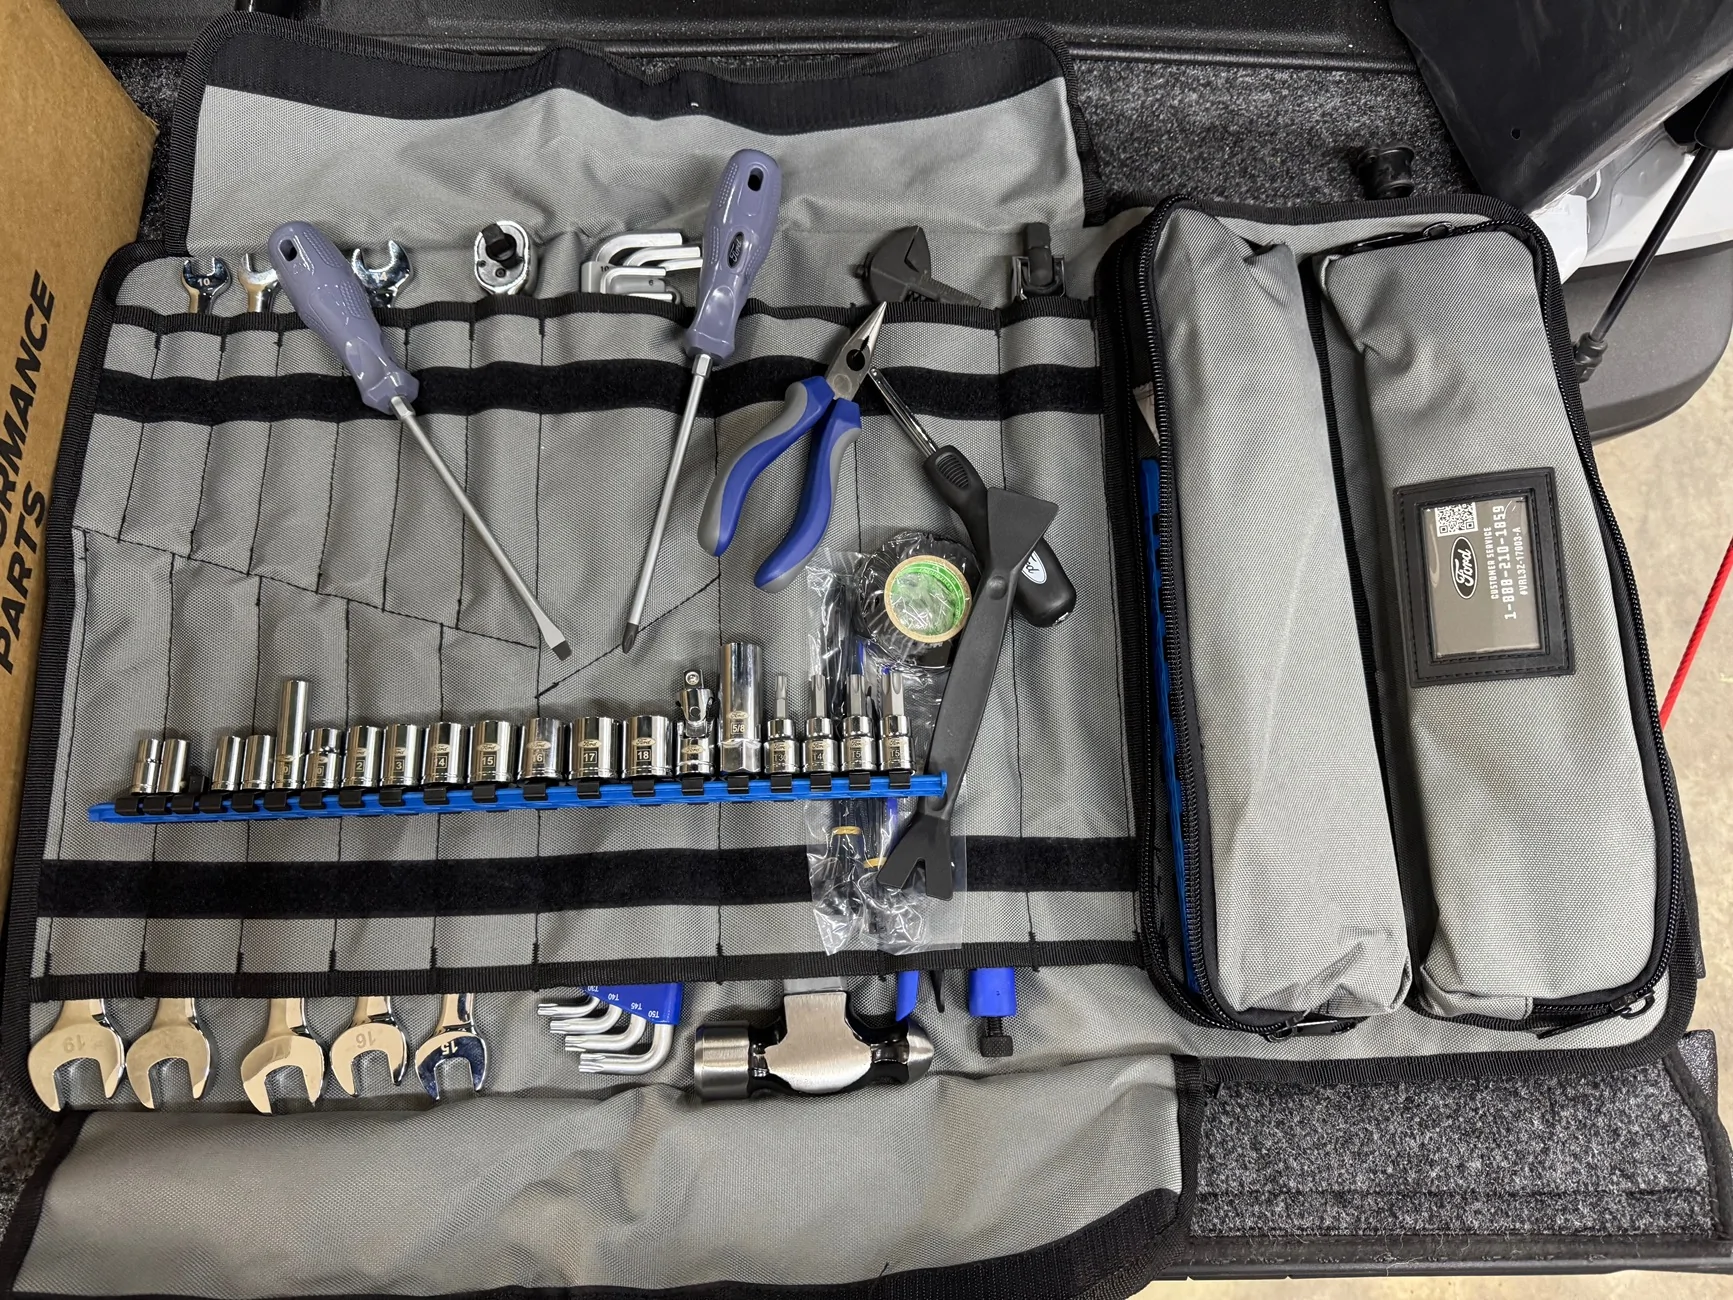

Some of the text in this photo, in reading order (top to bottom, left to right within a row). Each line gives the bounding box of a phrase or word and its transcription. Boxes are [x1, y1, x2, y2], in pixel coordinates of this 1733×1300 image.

[729, 238, 742, 262] Ford
[197, 278, 211, 287] 10
[1455, 548, 1475, 587] Ford
[1483, 526, 1499, 600] CUSTOMER SERVICE
[1492, 505, 1517, 620] 1-888-210-1859
[0, 481, 46, 675] PARTS
[732, 724, 745, 733] 5/8
[482, 756, 494, 765] 15
[583, 753, 595, 762] 17
[637, 750, 650, 760] 18
[608, 993, 619, 1001] T40
[631, 1002, 642, 1010] T45
[648, 1010, 660, 1019] T50
[62, 1034, 85, 1052] 19
[355, 1031, 376, 1049] 16
[440, 1040, 458, 1055] 15
